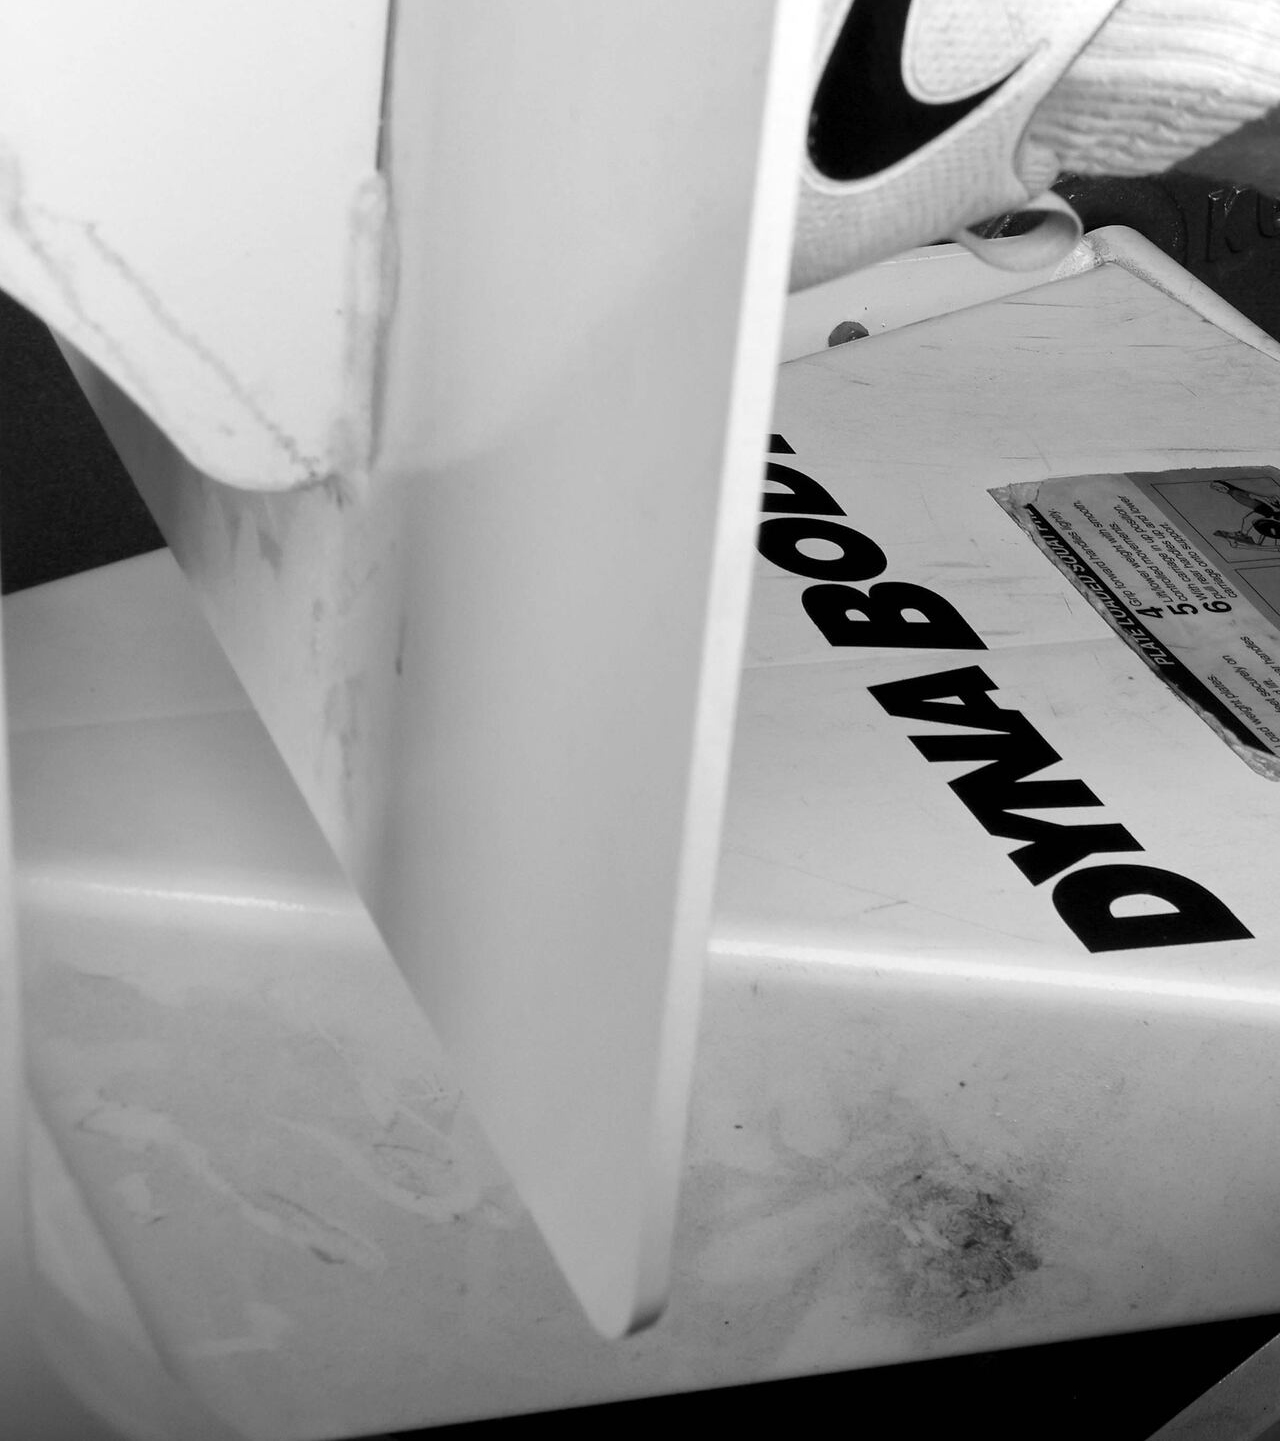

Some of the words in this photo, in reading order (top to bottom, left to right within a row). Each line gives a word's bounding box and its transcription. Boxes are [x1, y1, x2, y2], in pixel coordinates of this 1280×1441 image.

[1118, 496, 1141, 514] lower
[1135, 515, 1155, 528] and
[757, 434, 989, 650] BOD
[1099, 529, 1117, 543] with
[1141, 534, 1154, 543] up
[1152, 530, 1165, 539] up
[1068, 532, 1100, 560] handles
[1162, 541, 1194, 568] handles
[1112, 545, 1141, 568] weight
[1188, 551, 1208, 567] onto
[1093, 561, 1126, 589] forward
[1159, 553, 1191, 582] carriage
[1189, 570, 1209, 584] rear
[1136, 570, 1174, 602] Lift/lower
[1147, 566, 1188, 601] controlled
[1188, 584, 1208, 601] With
[1203, 586, 1226, 599] pull
[1205, 569, 1237, 598] carriage
[1123, 591, 1142, 606] Grip
[1203, 601, 1232, 613] 6
[1135, 607, 1163, 618] 4
[1167, 603, 1198, 615] 5
[1222, 655, 1237, 665] on
[1240, 636, 1275, 664] handles
[1208, 674, 1239, 698] plates.
[1233, 667, 1271, 697] securely
[1230, 700, 1261, 725] weight
[866, 665, 1256, 954] DYNA
